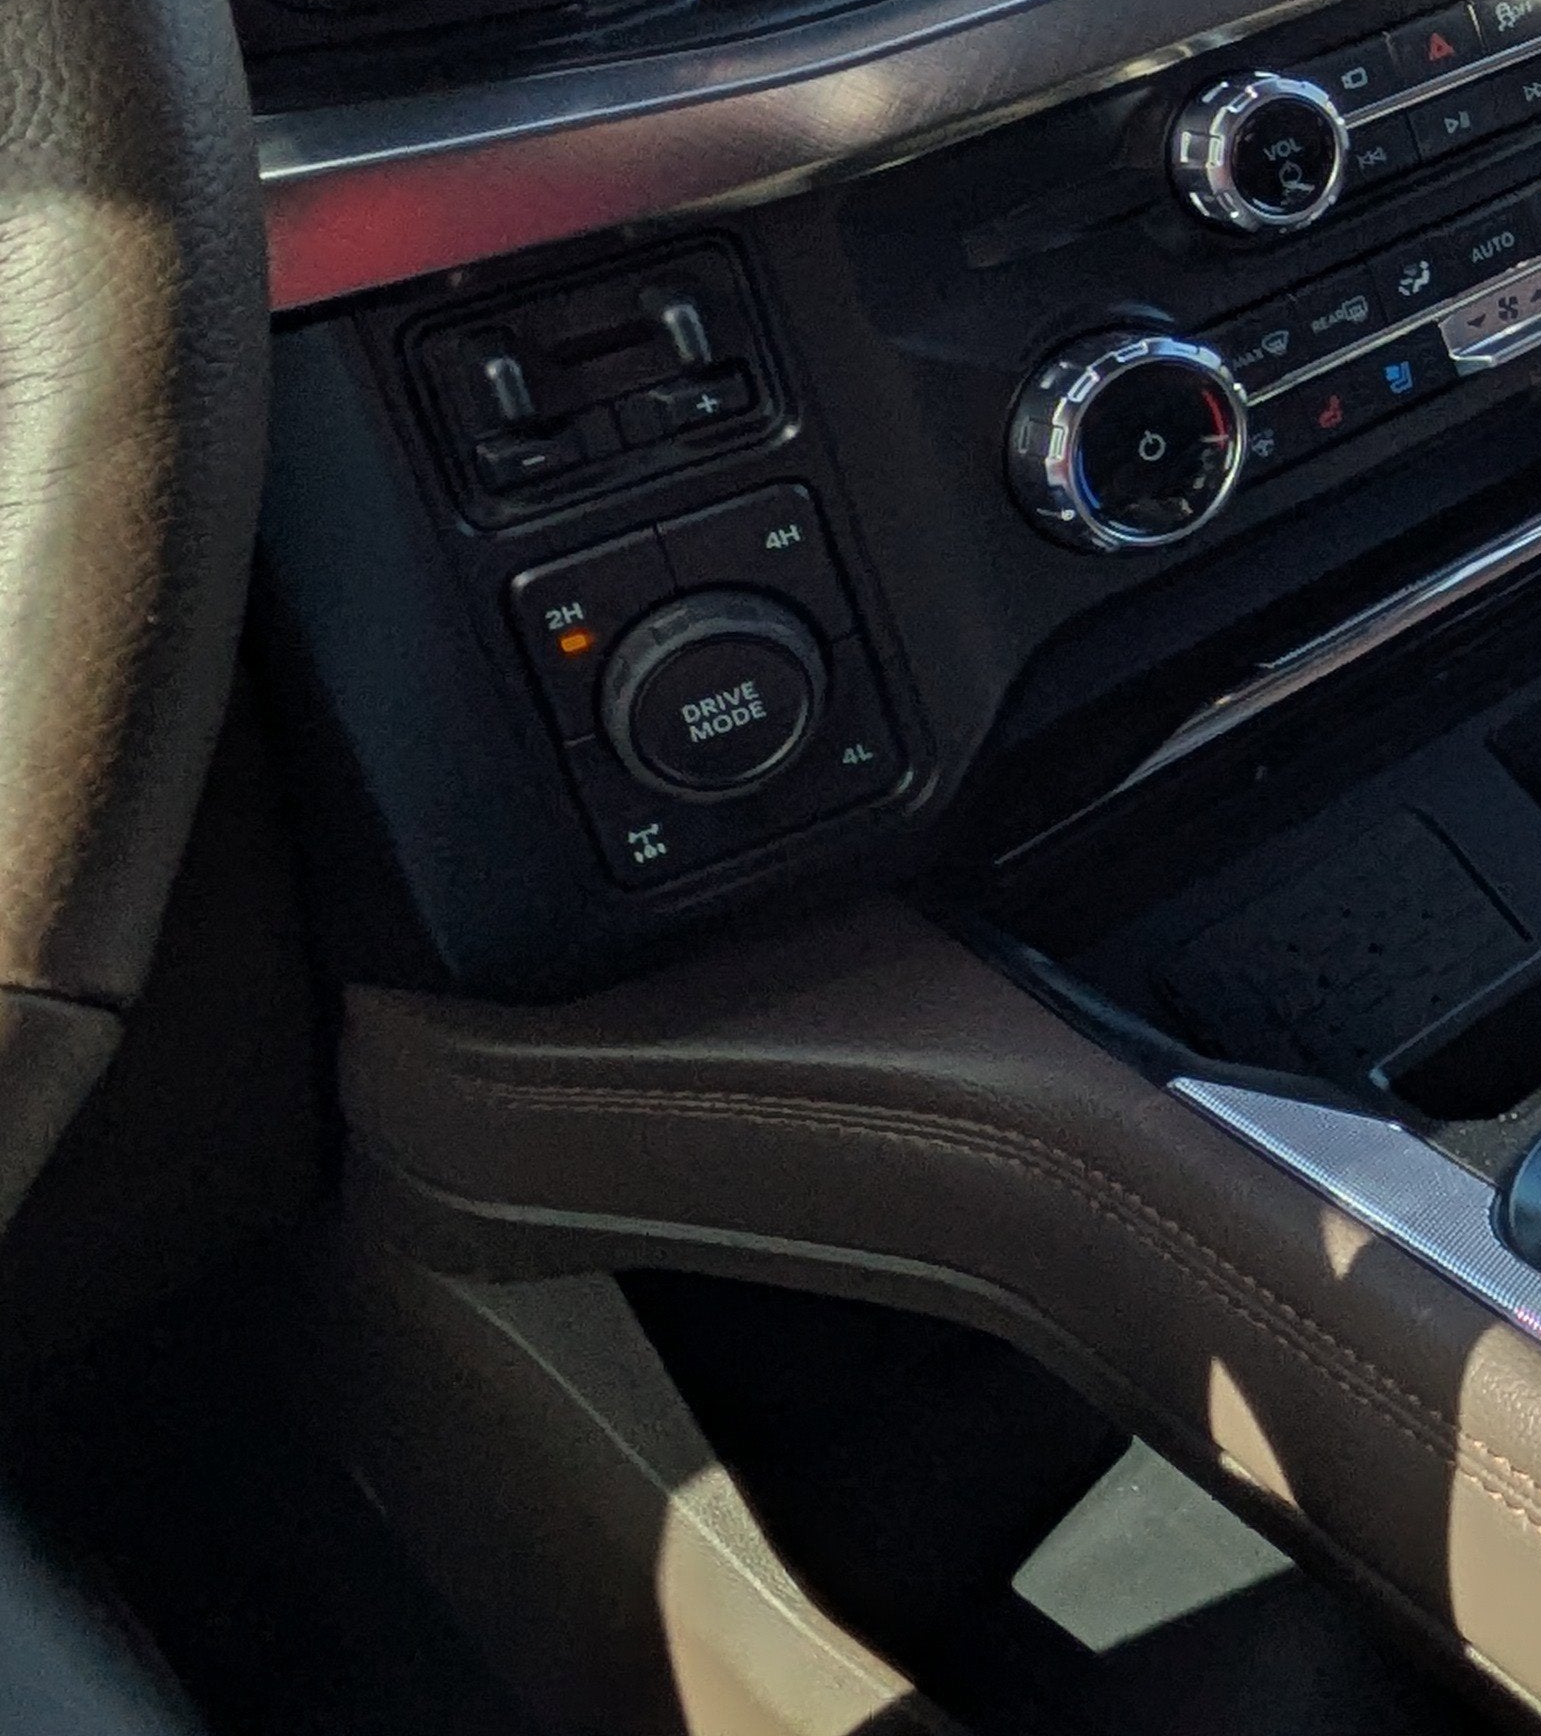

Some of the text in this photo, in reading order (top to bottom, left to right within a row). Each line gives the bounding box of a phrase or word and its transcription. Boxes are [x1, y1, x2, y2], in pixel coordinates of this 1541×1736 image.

[1262, 138, 1304, 162] VOL
[1469, 230, 1515, 265] AUTO
[765, 523, 802, 551] 4H
[545, 601, 584, 630] 2H
[681, 679, 760, 725] DRIVE
[688, 698, 768, 744] MODE
[841, 741, 875, 766] 4L
